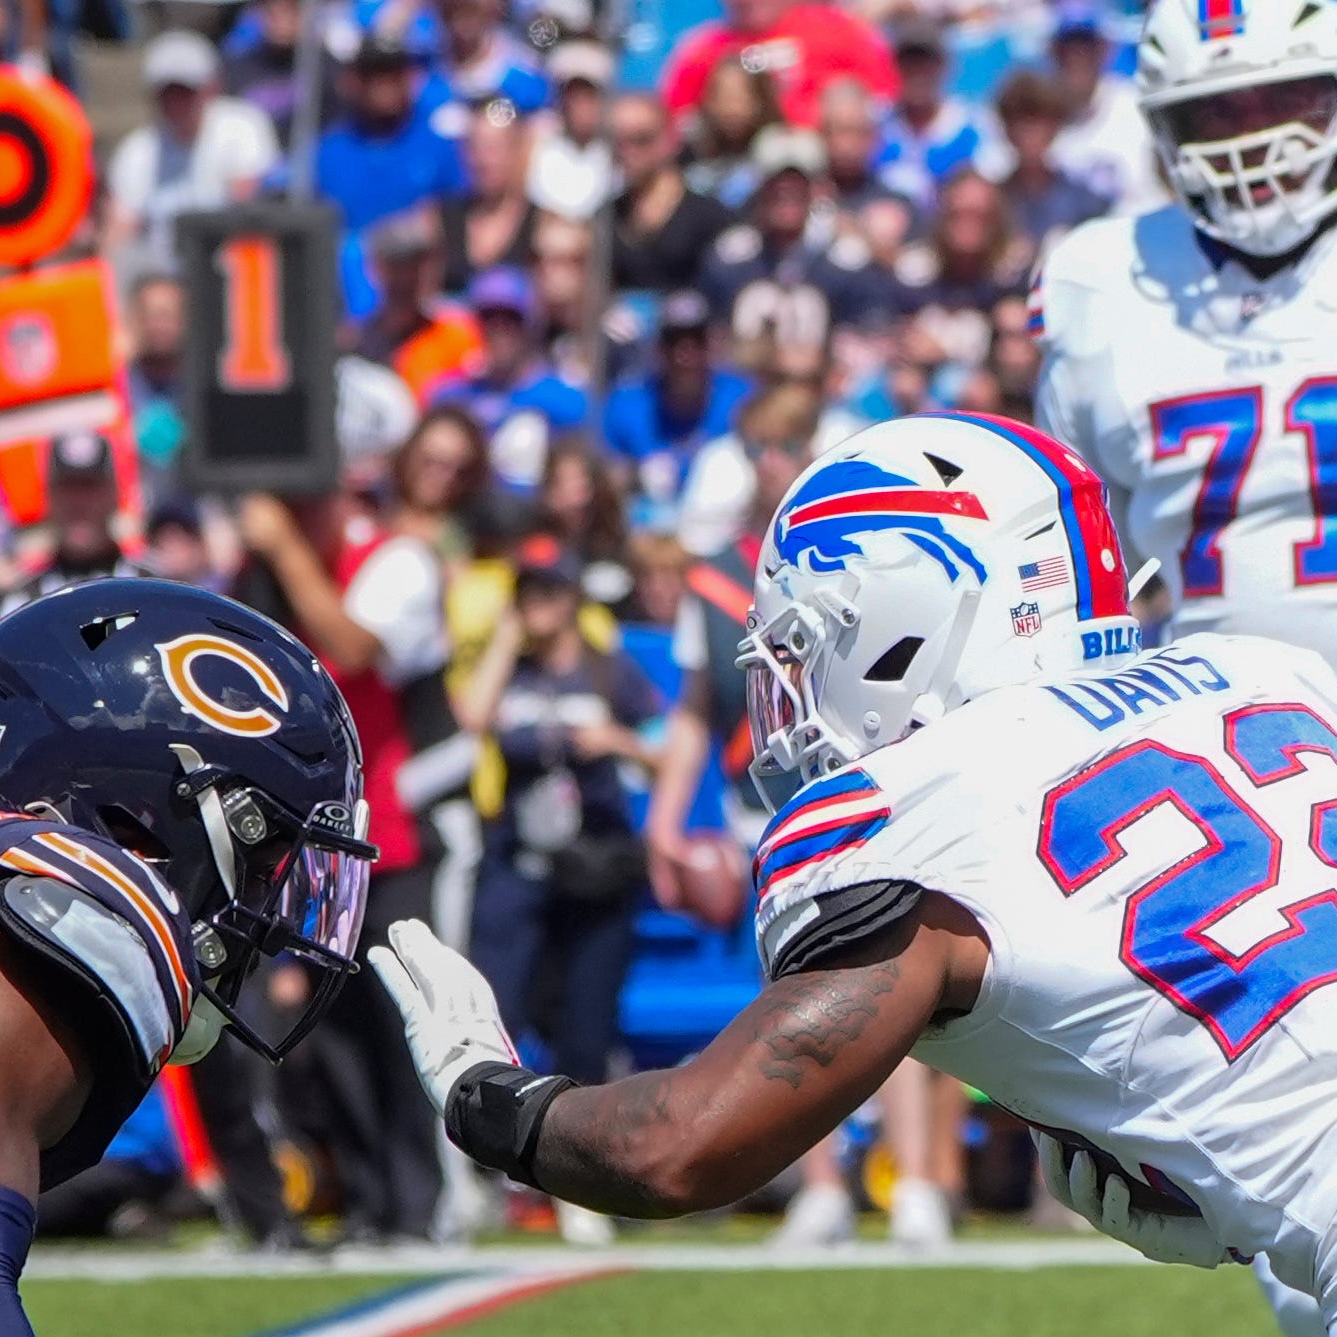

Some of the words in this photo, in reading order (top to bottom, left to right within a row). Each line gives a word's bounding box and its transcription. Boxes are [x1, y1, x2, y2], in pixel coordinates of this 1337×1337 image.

[216, 236, 292, 392] 1
[1015, 614, 1041, 635] NFL
[154, 634, 289, 738] C
[1039, 646, 1231, 732] DAVIS
[312, 814, 351, 832] OAKLEY
